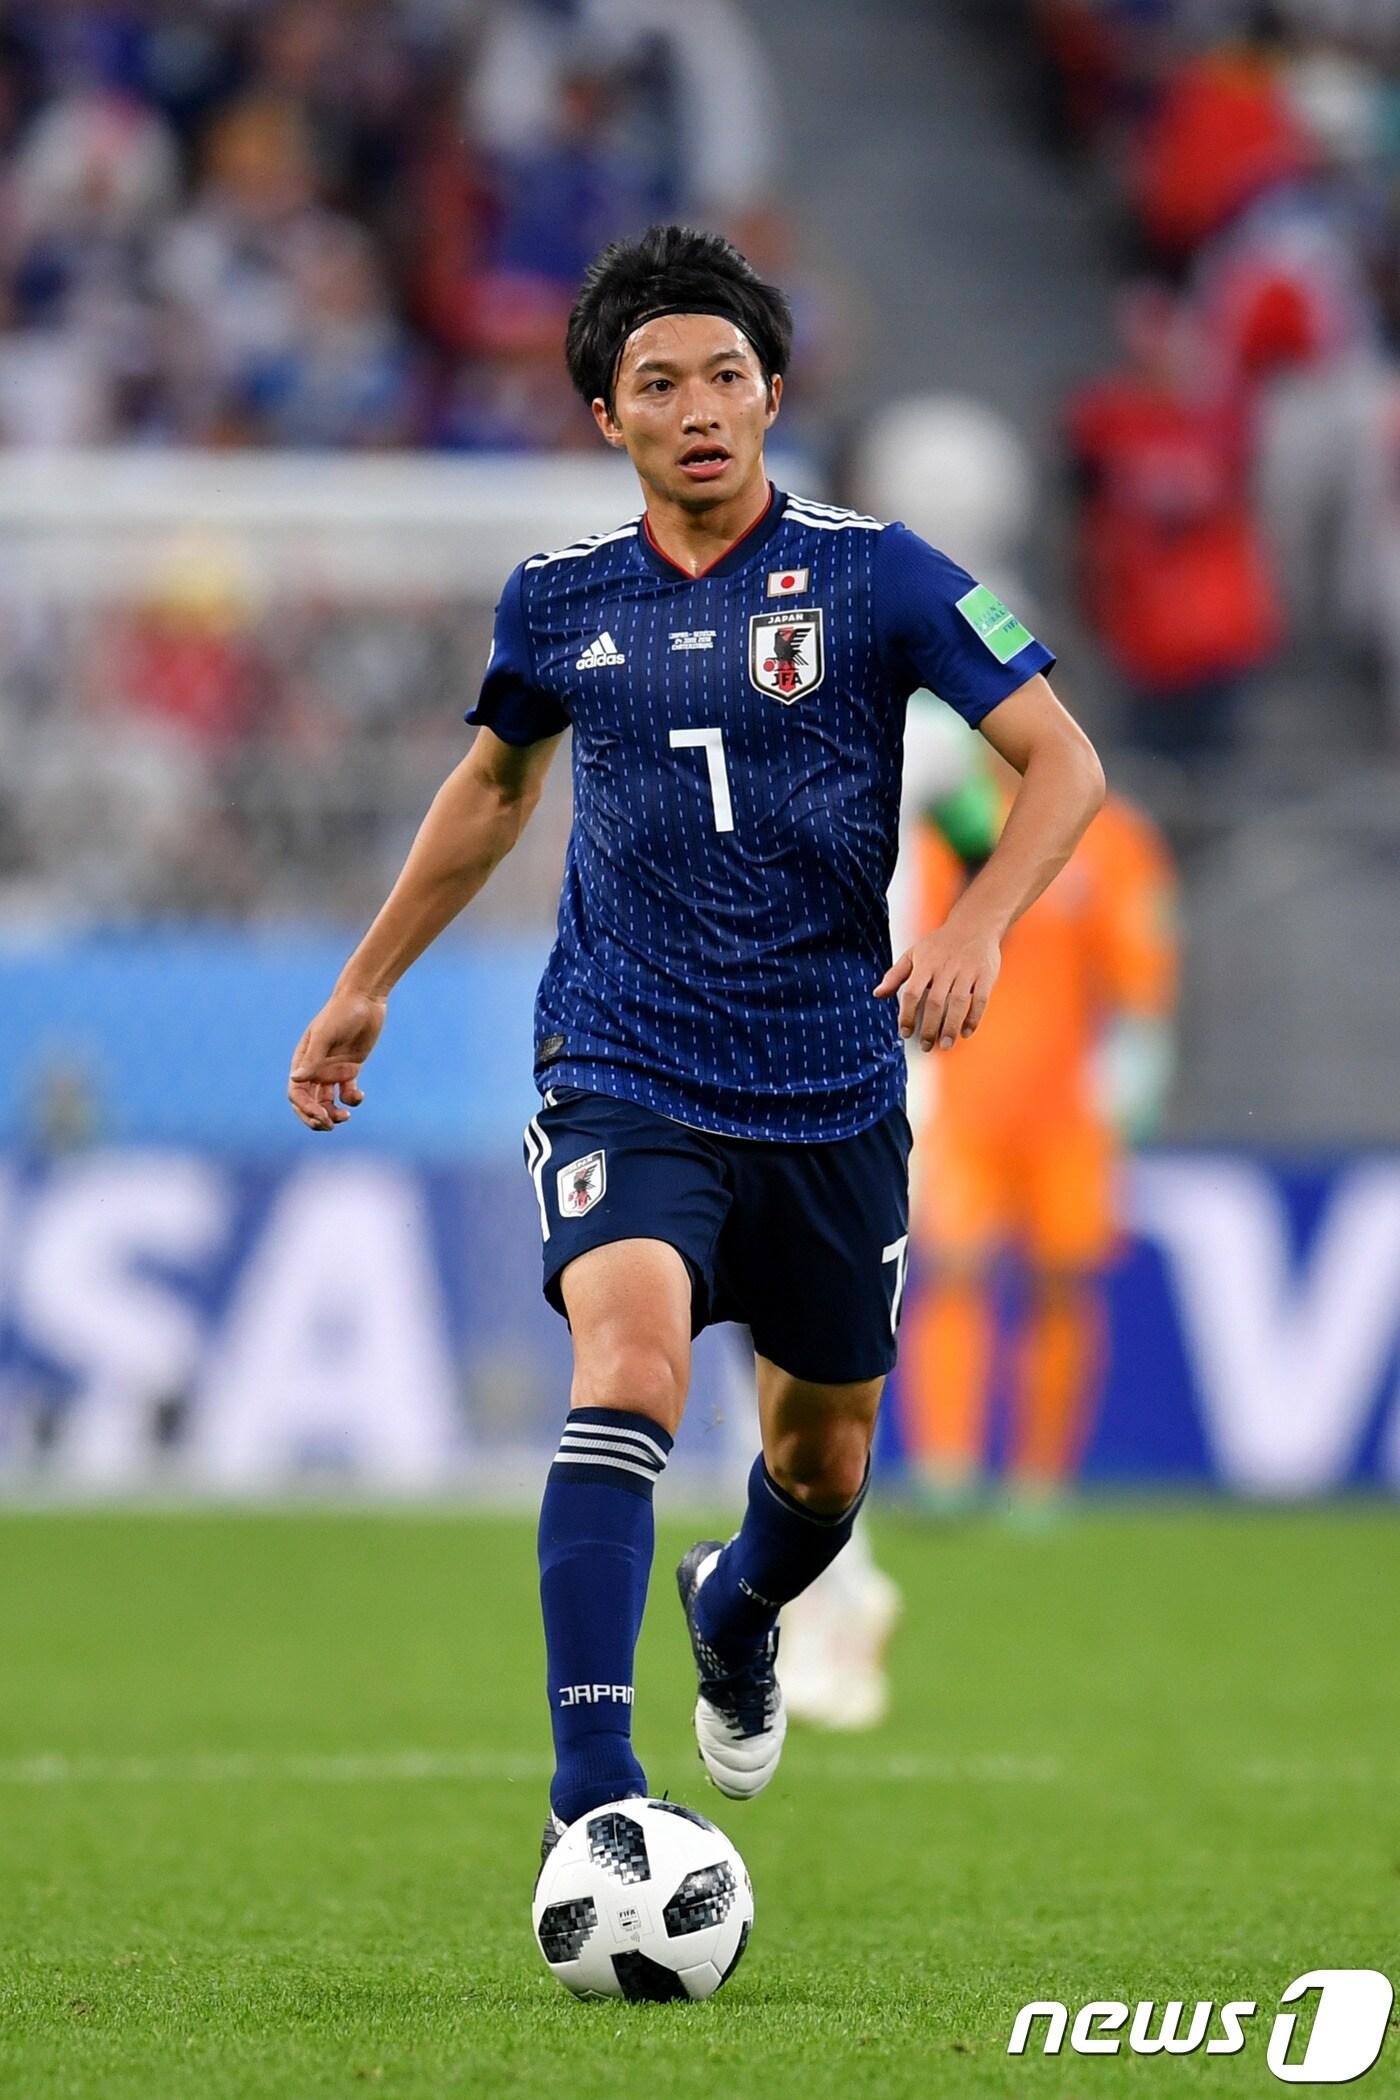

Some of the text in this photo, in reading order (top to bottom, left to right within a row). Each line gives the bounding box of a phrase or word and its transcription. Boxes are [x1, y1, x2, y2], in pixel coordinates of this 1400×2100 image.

[768, 613, 804, 624] JAPAN
[575, 653, 626, 670] adidas
[771, 672, 803, 686] JFA
[669, 727, 734, 832] 7
[0, 1147, 462, 1497] SA
[1128, 1156, 1400, 1493] V
